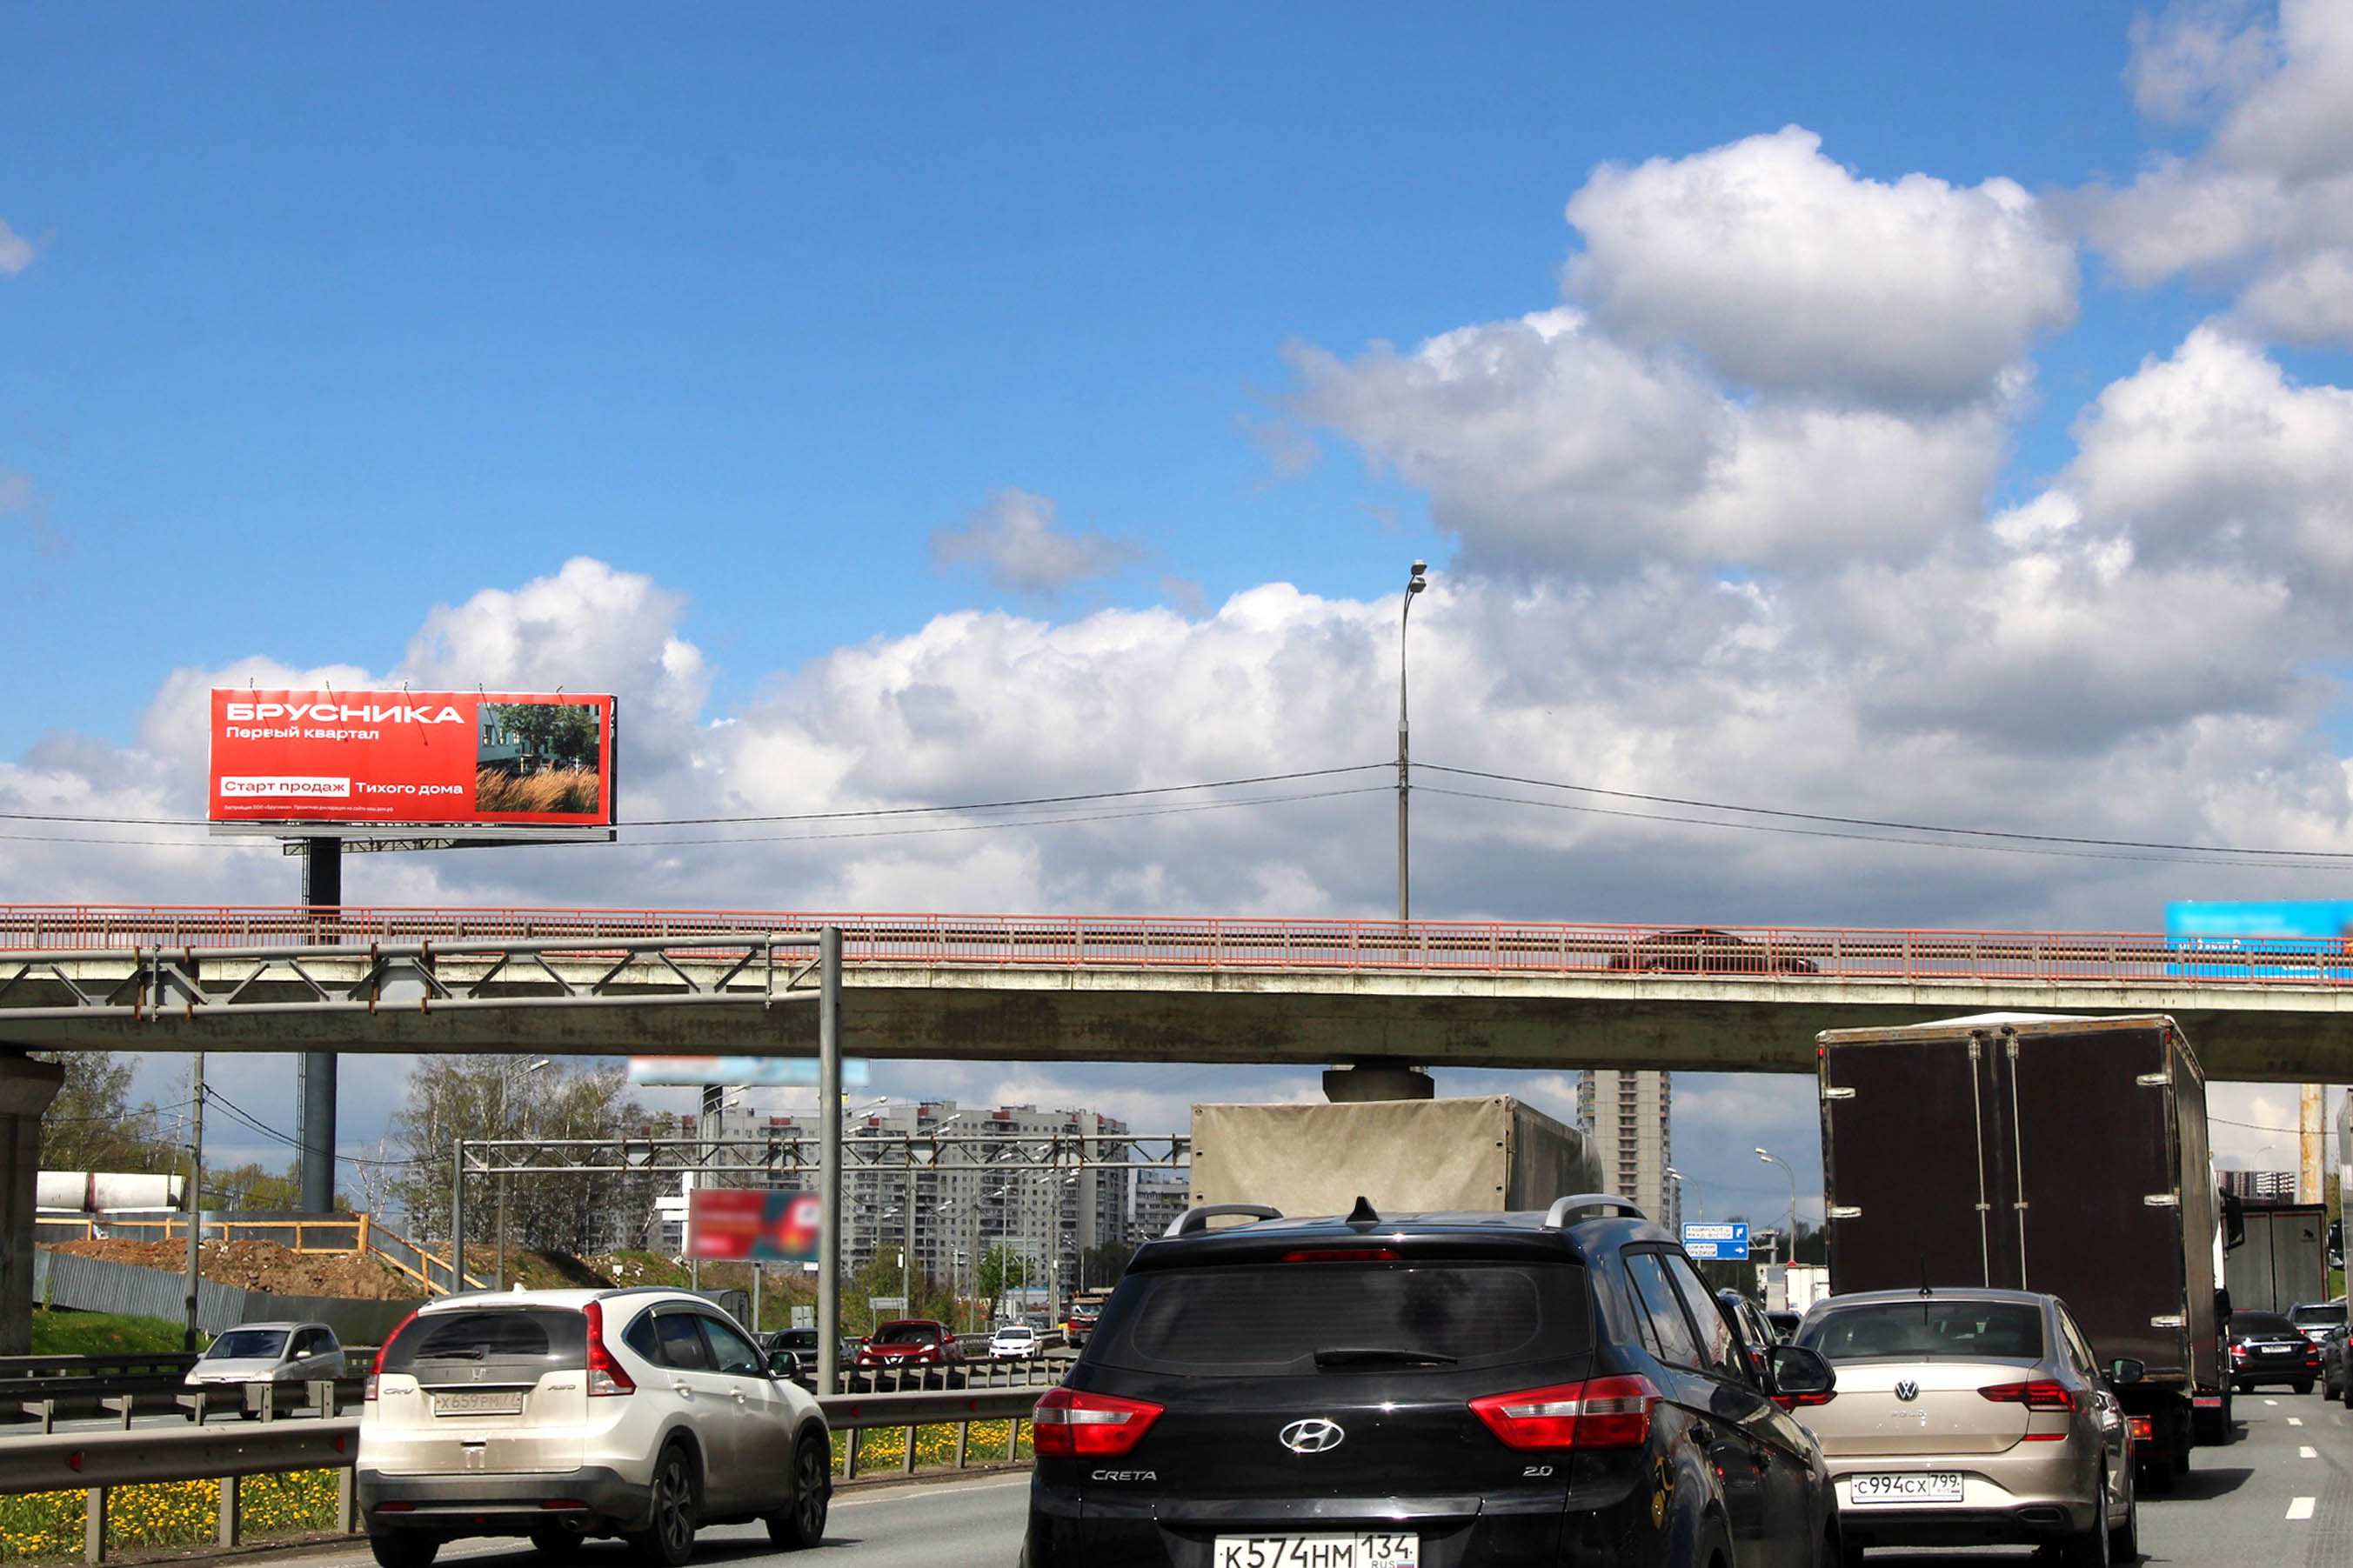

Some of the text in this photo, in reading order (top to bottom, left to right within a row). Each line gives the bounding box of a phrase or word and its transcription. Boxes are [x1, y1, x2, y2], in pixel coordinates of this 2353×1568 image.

[227, 703, 465, 724] БРУСНИКА
[226, 726, 379, 741] Первый квартал
[224, 781, 464, 796] Старт продаж Тихого дома
[1092, 1469, 1158, 1481] CRETA
[1930, 1474, 1957, 1488] 799
[1361, 1534, 1409, 1559] 134
